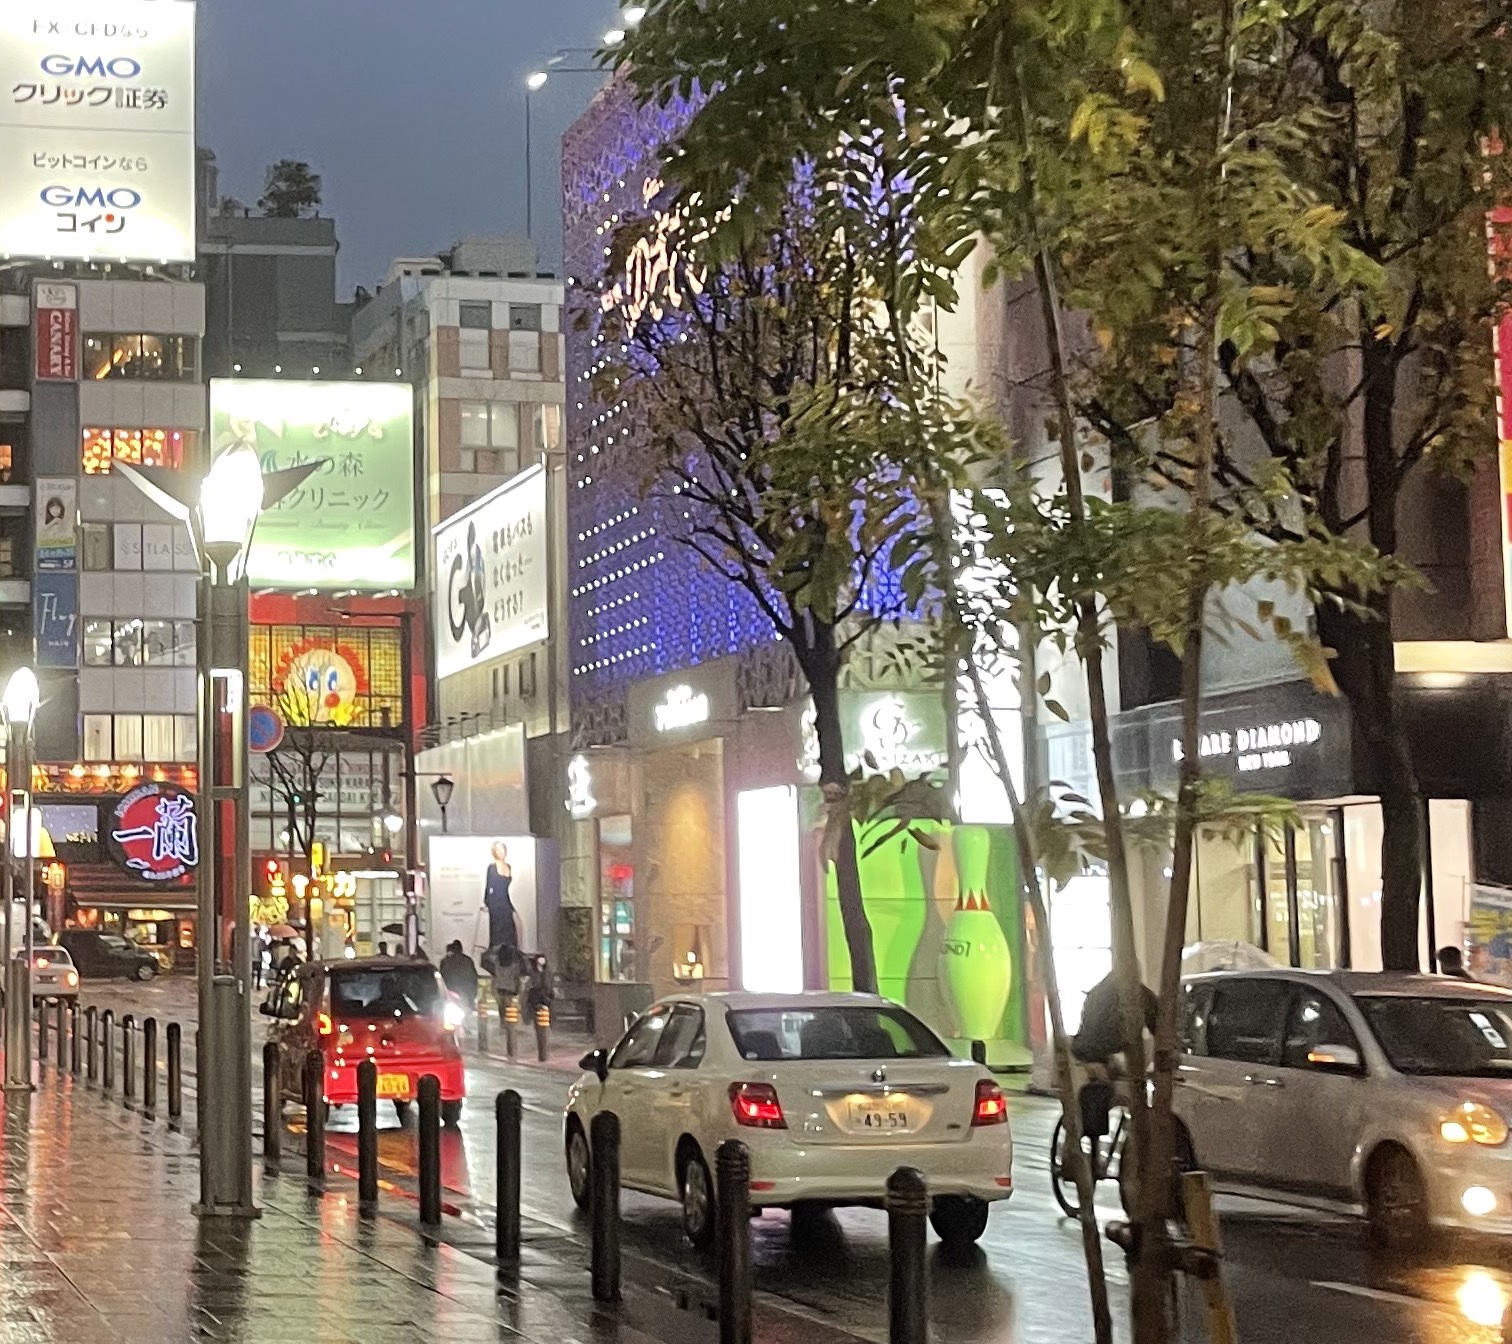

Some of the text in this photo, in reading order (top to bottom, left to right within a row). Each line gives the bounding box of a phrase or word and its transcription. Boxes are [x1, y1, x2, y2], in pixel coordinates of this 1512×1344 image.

[40, 54, 141, 79] GMO
[12, 83, 169, 110] クリック証券
[33, 151, 148, 172] ビットコインなら
[40, 185, 142, 209] GMO
[56, 212, 126, 234] コイン
[287, 486, 390, 512] クリニック
[1172, 718, 1322, 761] LARE DIAMOND
[111, 794, 199, 866] 一蘭
